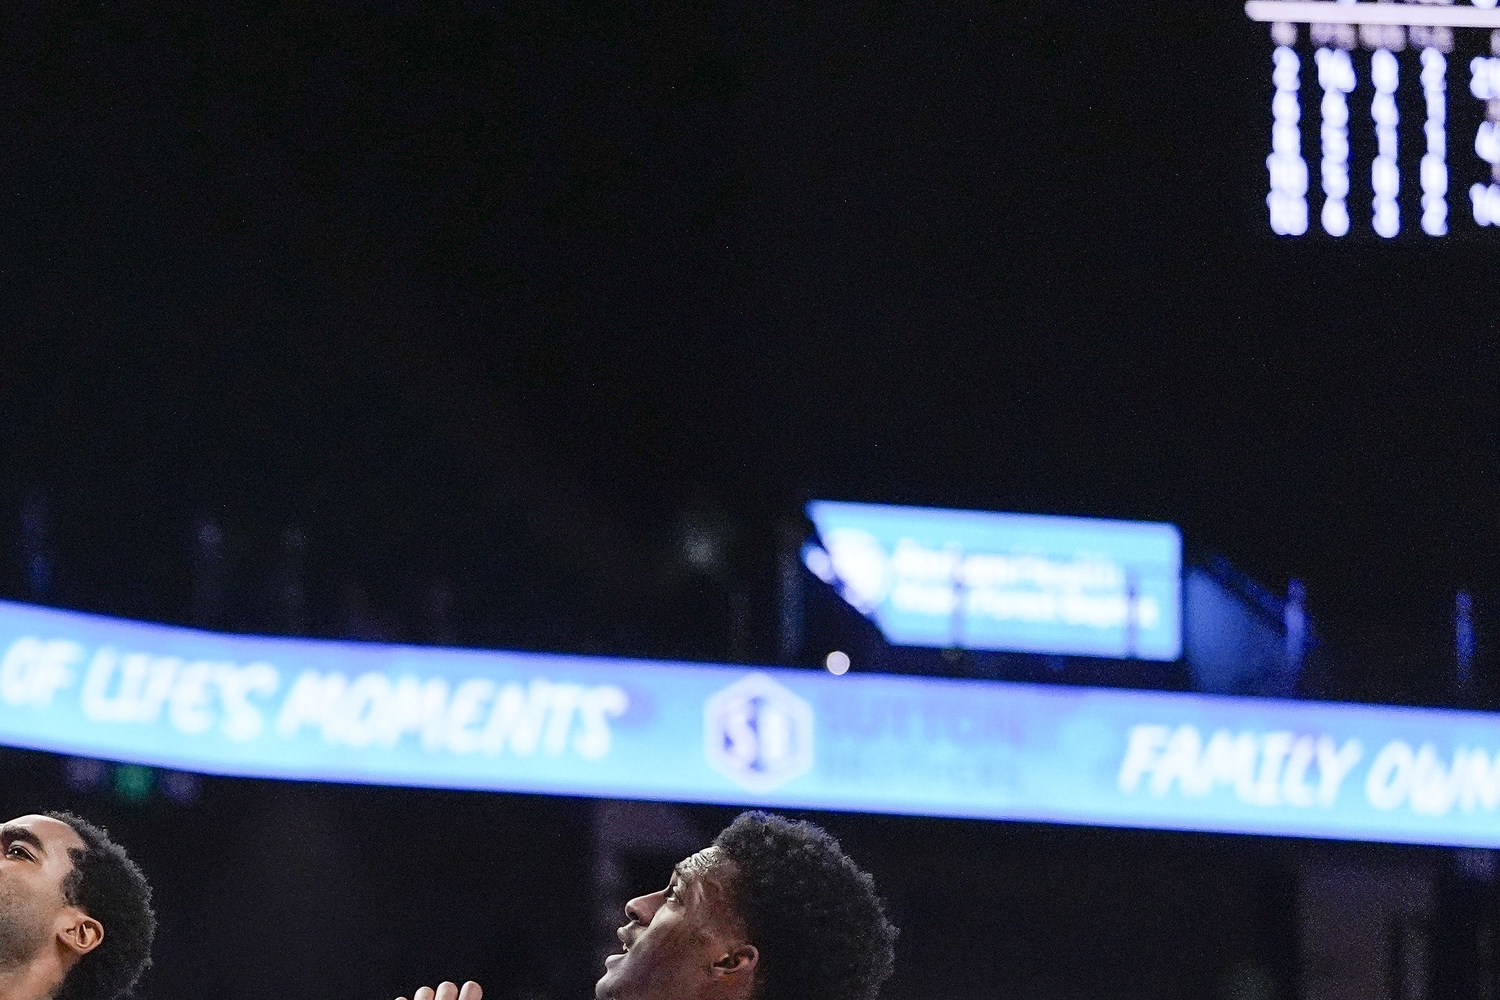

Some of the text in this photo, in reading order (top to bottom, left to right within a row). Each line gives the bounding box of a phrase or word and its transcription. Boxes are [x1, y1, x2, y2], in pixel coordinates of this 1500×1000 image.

[86, 647, 279, 743] LIFE'S
[276, 667, 628, 761] MOMENTS
[1117, 723, 1363, 808] FAMILY
